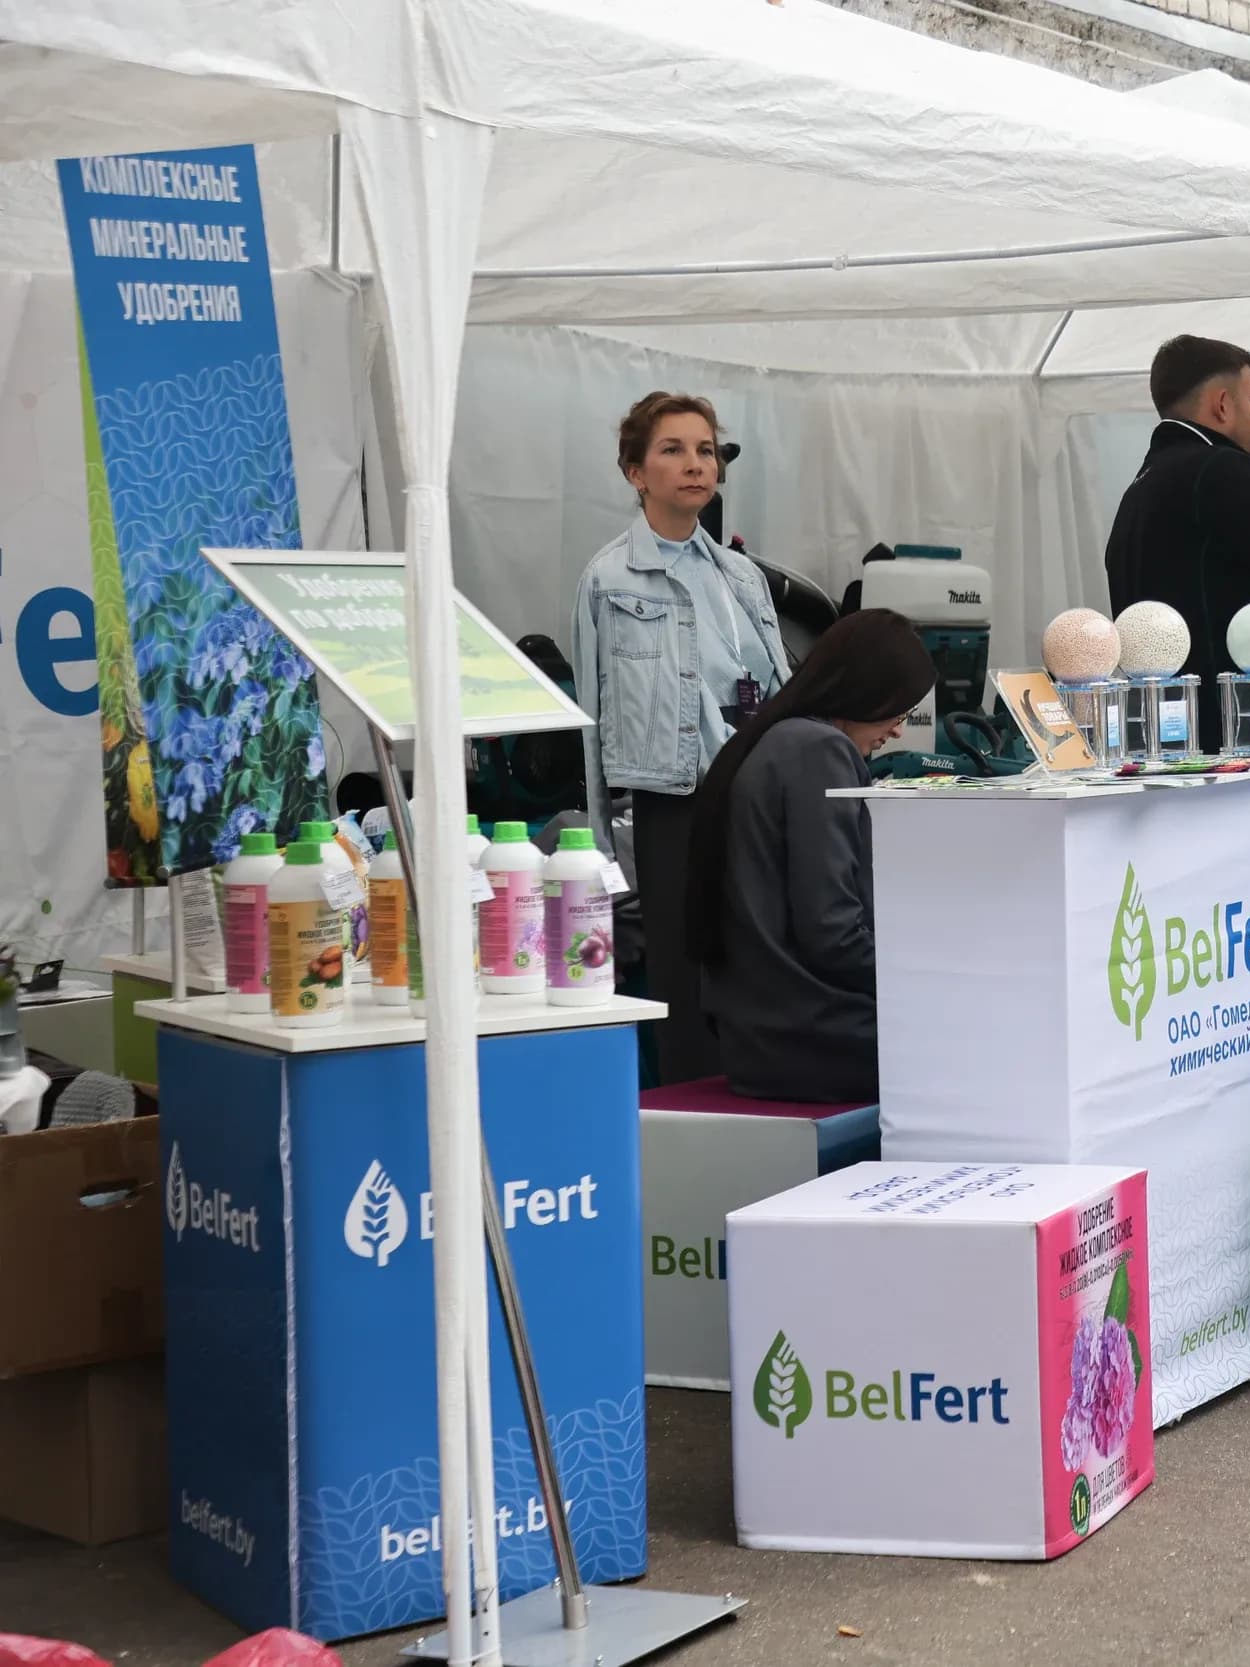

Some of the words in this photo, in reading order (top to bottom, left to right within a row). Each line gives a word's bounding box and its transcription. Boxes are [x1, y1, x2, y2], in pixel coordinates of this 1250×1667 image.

[80, 157, 242, 203] КОМПЛЕКСНЫЕ
[90, 218, 249, 263] МИНЕРАЛЬНЫЕ
[117, 282, 242, 325] УДОБРЕНИЯ
[1168, 1011, 1200, 1044] ОАО
[190, 1182, 260, 1252] BelFert
[1077, 1196, 1114, 1236] УДОБРЕНИЕ
[1060, 1241, 1088, 1277] ЖИДКОЕ
[1088, 1216, 1133, 1260] КОМПЛЕКСНОЕ
[1180, 1304, 1249, 1356] belfert.by
[825, 1369, 1010, 1425] BelFert
